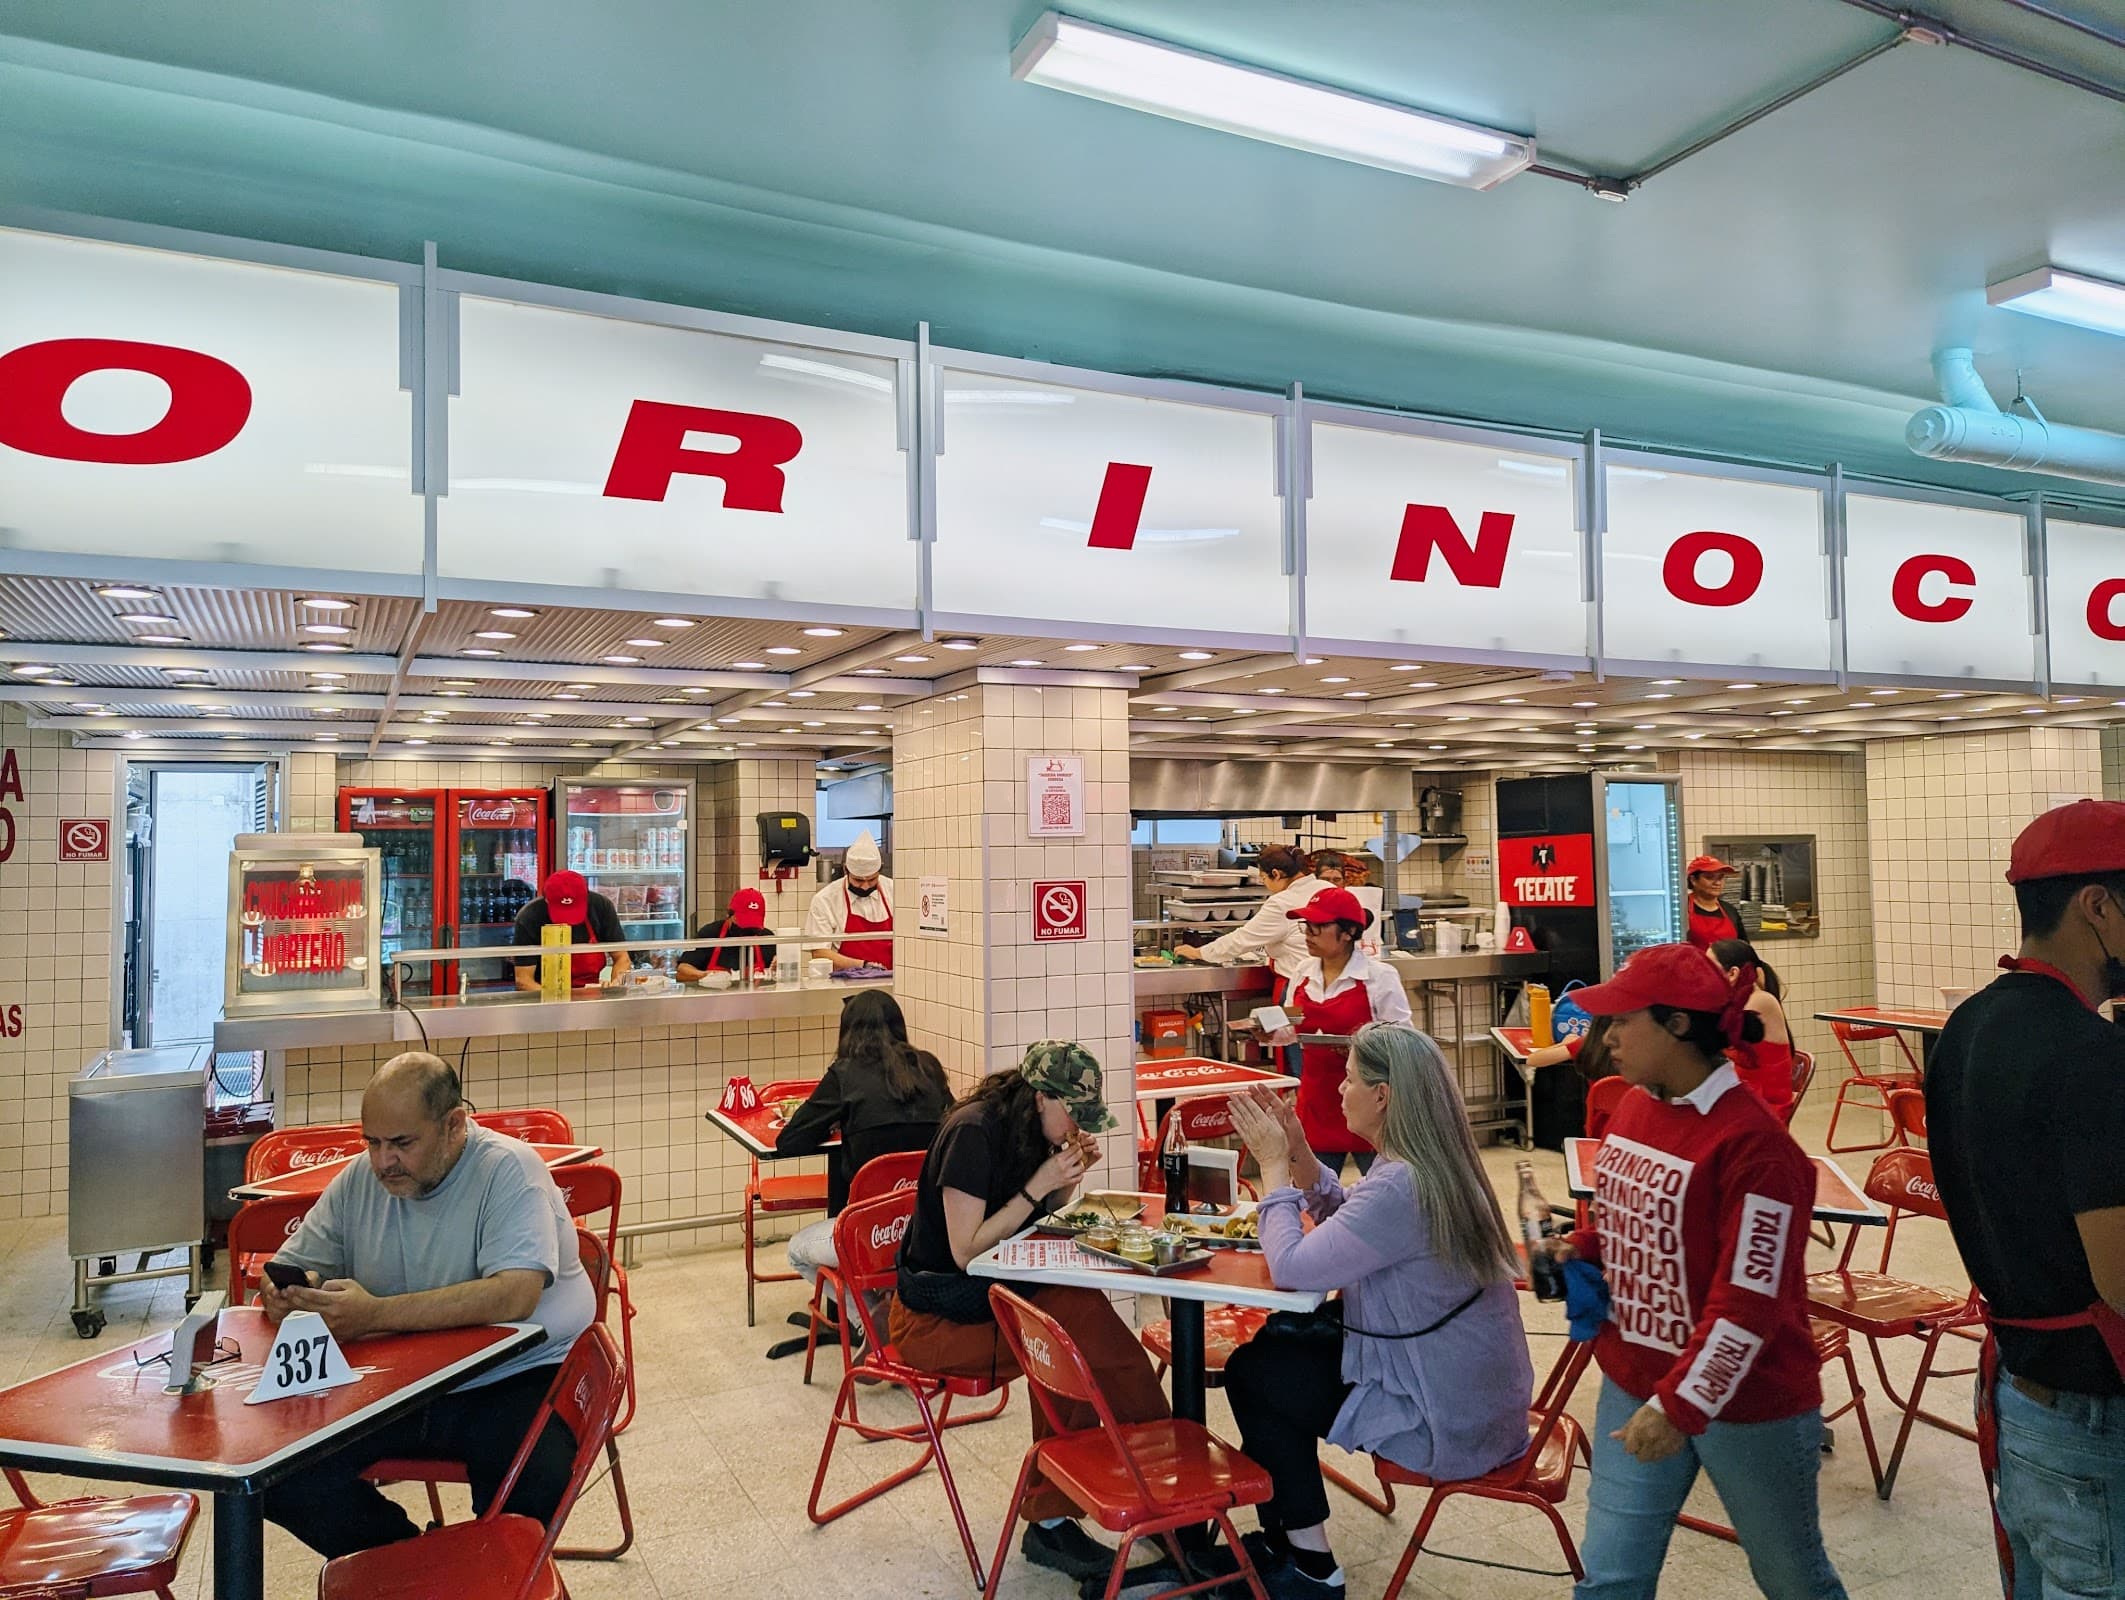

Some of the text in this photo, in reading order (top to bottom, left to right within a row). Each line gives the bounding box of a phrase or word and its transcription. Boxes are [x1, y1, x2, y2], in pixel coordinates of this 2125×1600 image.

[1513, 876, 1579, 902] TECATE
[1053, 926, 1081, 935] FUMAR
[1515, 930, 1524, 946] 2
[724, 1085, 736, 1110] 86
[740, 1084, 755, 1108] 86
[1597, 1173, 1677, 1226] RINOCO
[1744, 1210, 1782, 1285] TACOS
[276, 1335, 330, 1388] 337
[1692, 1334, 1754, 1404] TROMPO
